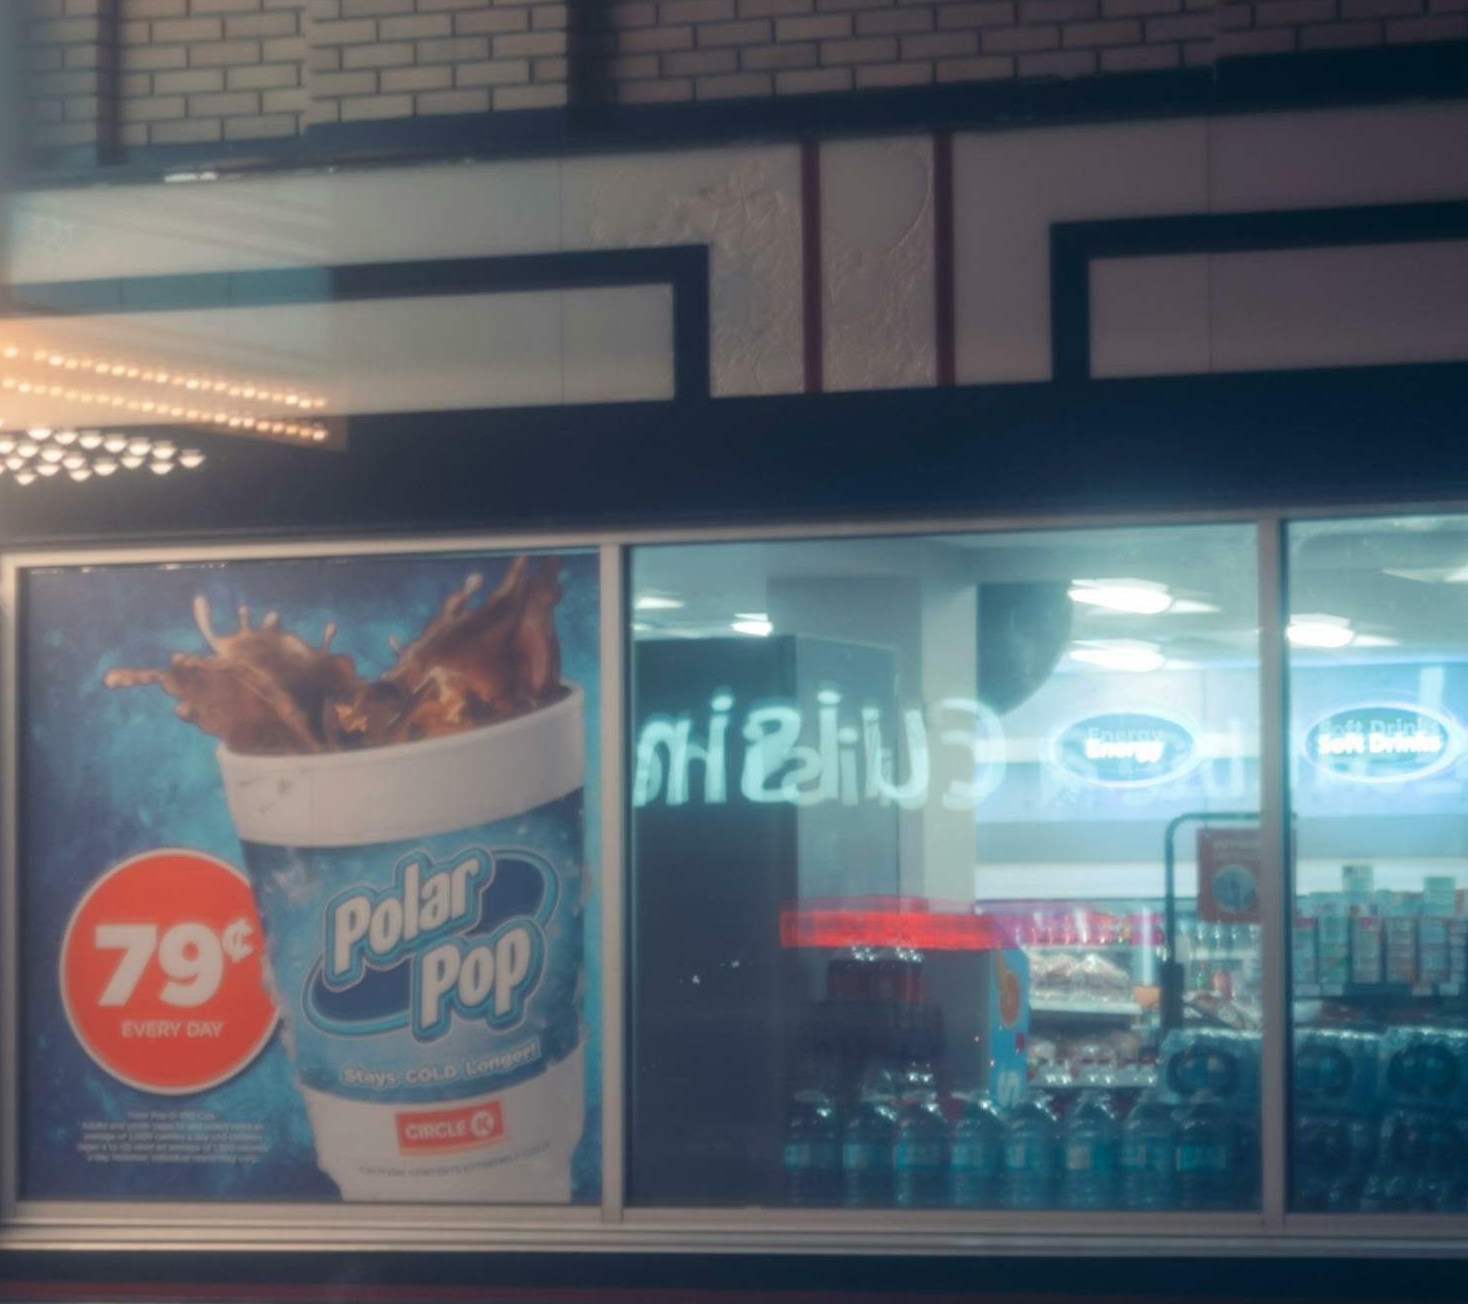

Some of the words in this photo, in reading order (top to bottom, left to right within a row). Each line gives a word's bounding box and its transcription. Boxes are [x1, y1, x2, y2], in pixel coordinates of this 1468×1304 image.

[1317, 718, 1366, 756] Soft
[1369, 718, 1443, 756] Drinks
[334, 857, 480, 976] Polar
[420, 926, 531, 1030] Pop
[121, 1020, 184, 1038] EVERY
[187, 1021, 225, 1038] DAY
[343, 1067, 398, 1086] Stays
[404, 1064, 458, 1083] COLD
[465, 1041, 538, 1077] Longer!
[405, 1118, 467, 1141] CIRCLE
[470, 1110, 495, 1138] K
